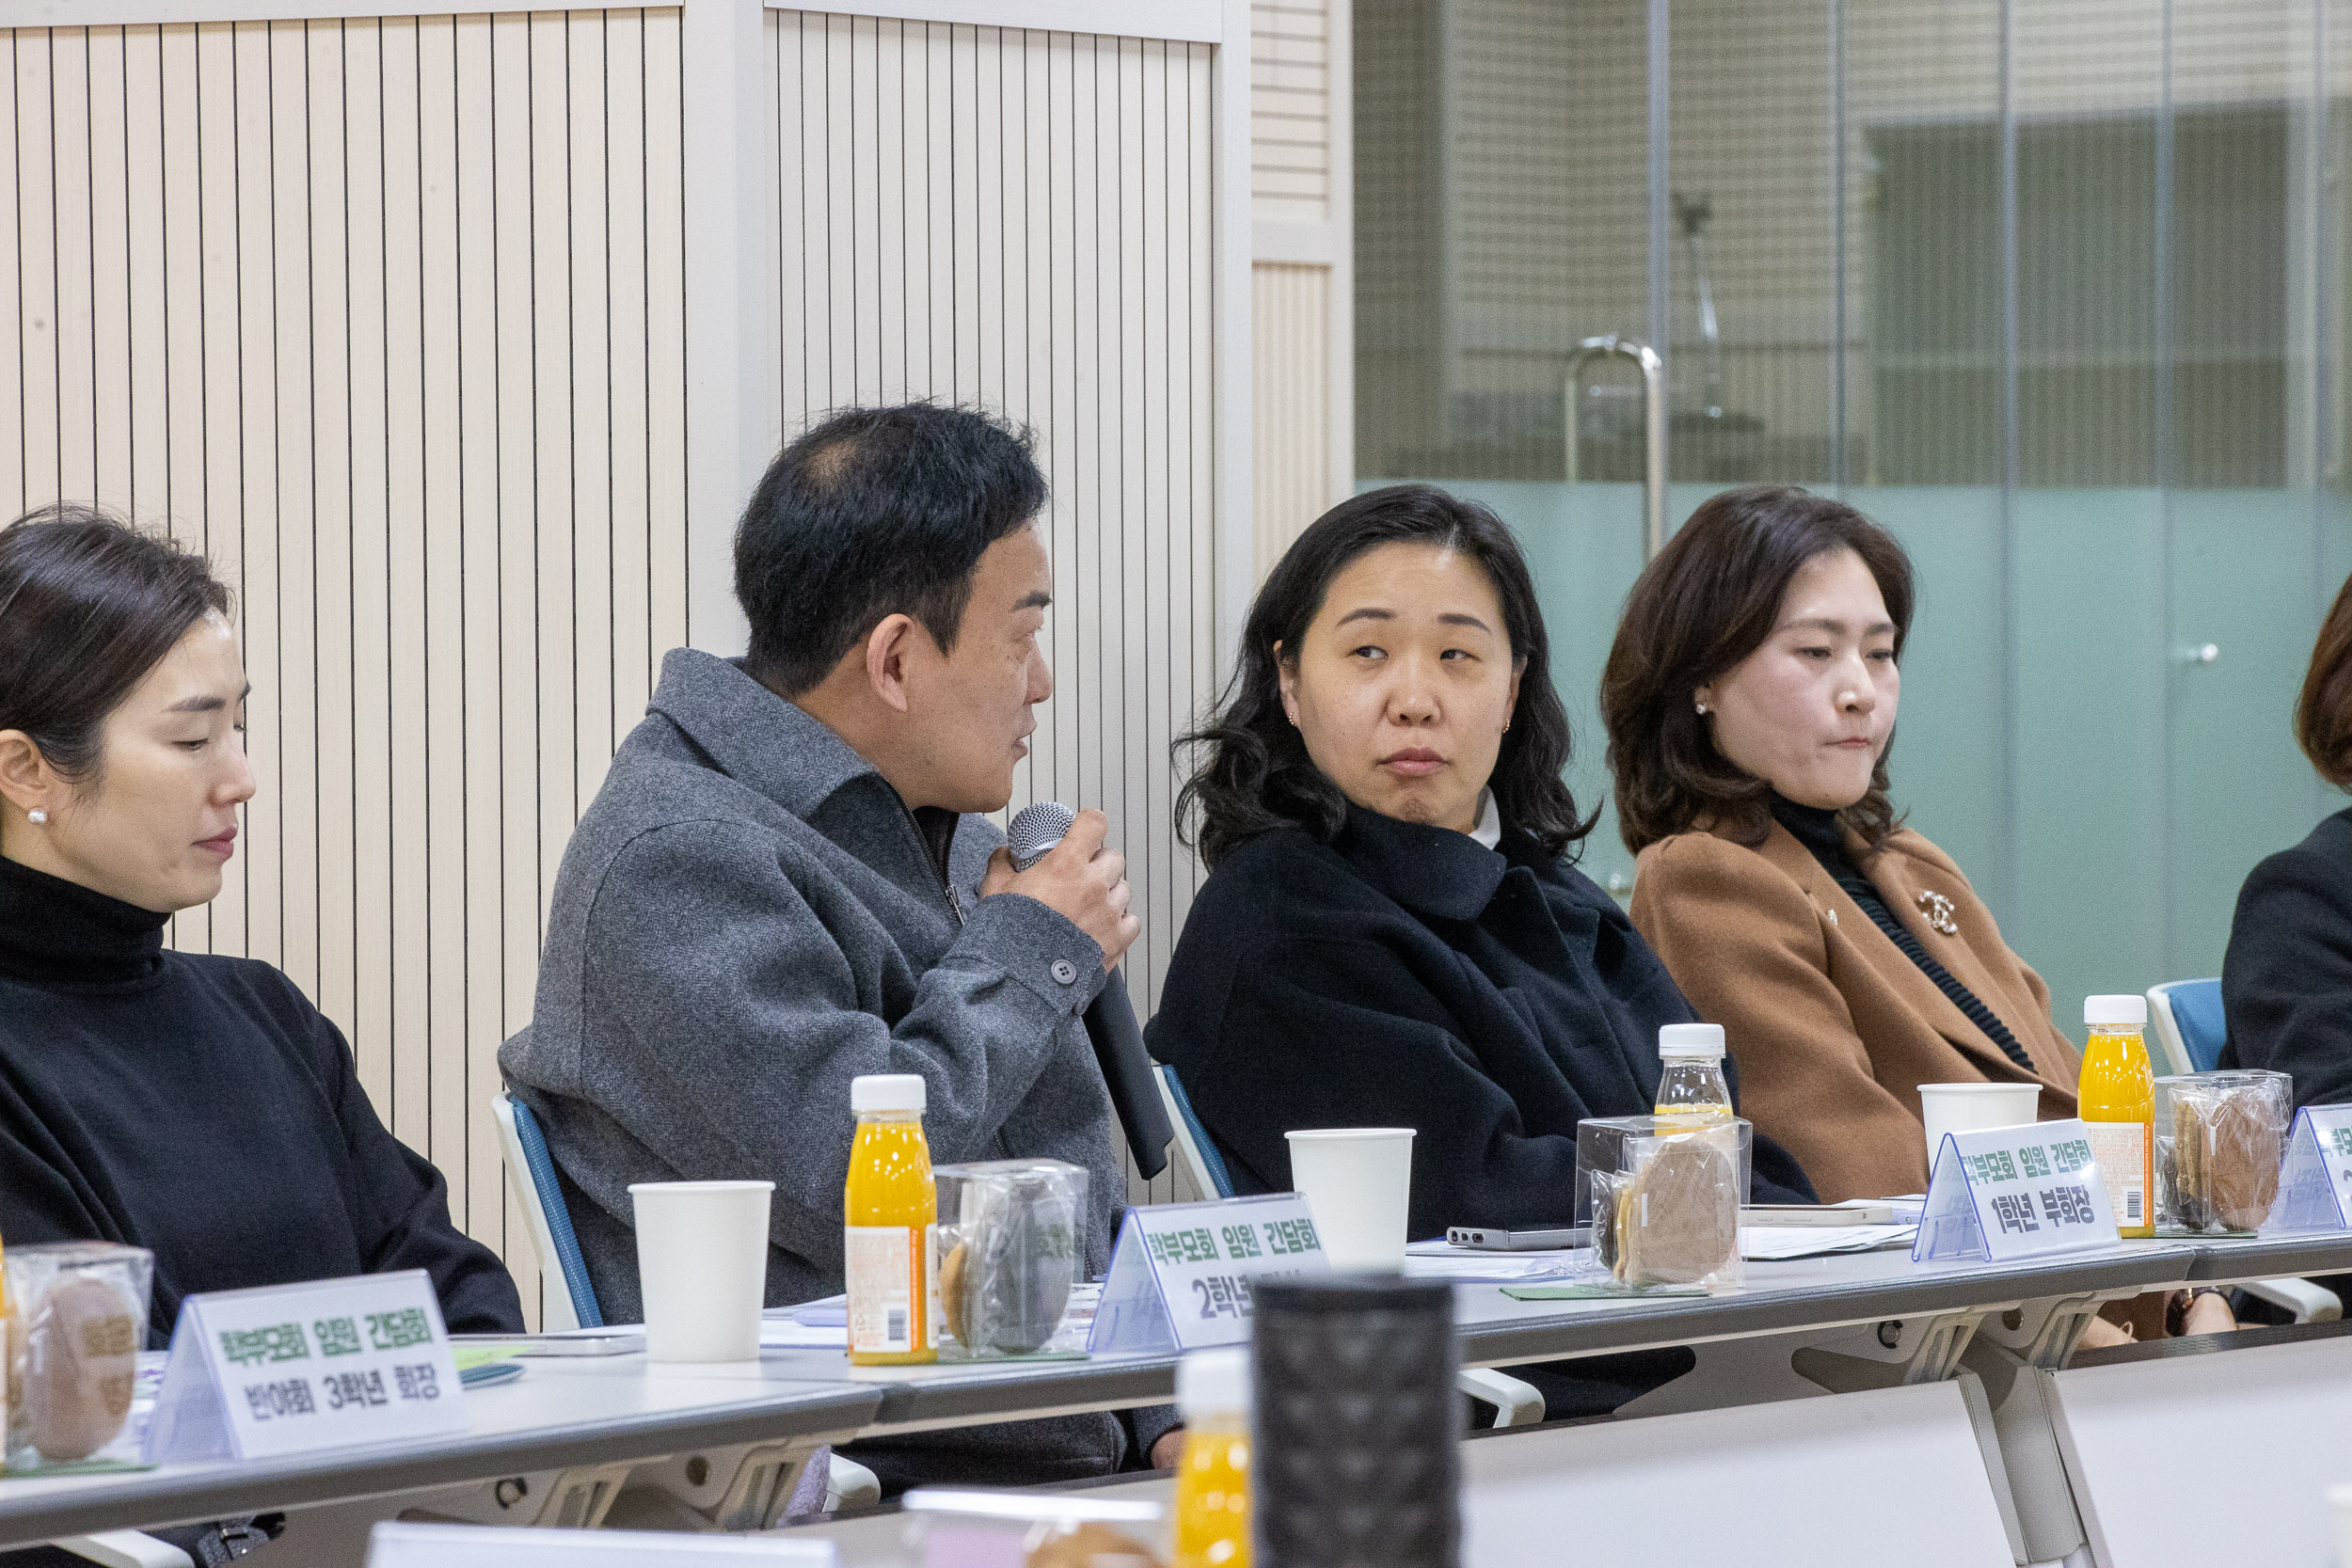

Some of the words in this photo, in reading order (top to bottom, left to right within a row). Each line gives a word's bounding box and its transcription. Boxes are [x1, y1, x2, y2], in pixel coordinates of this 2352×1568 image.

[2019, 1145, 2051, 1178] 임원
[1991, 1192, 2040, 1234] 1학년
[2040, 1184, 2095, 1227] 부회장
[1147, 1227, 1219, 1265] 학부모회
[1222, 1224, 1263, 1259] 임원
[1263, 1218, 1322, 1255] 간담회
[313, 1316, 362, 1356] 임원
[365, 1307, 433, 1350] 간담회
[323, 1369, 389, 1410] 3학년
[393, 1362, 440, 1402] 회장
